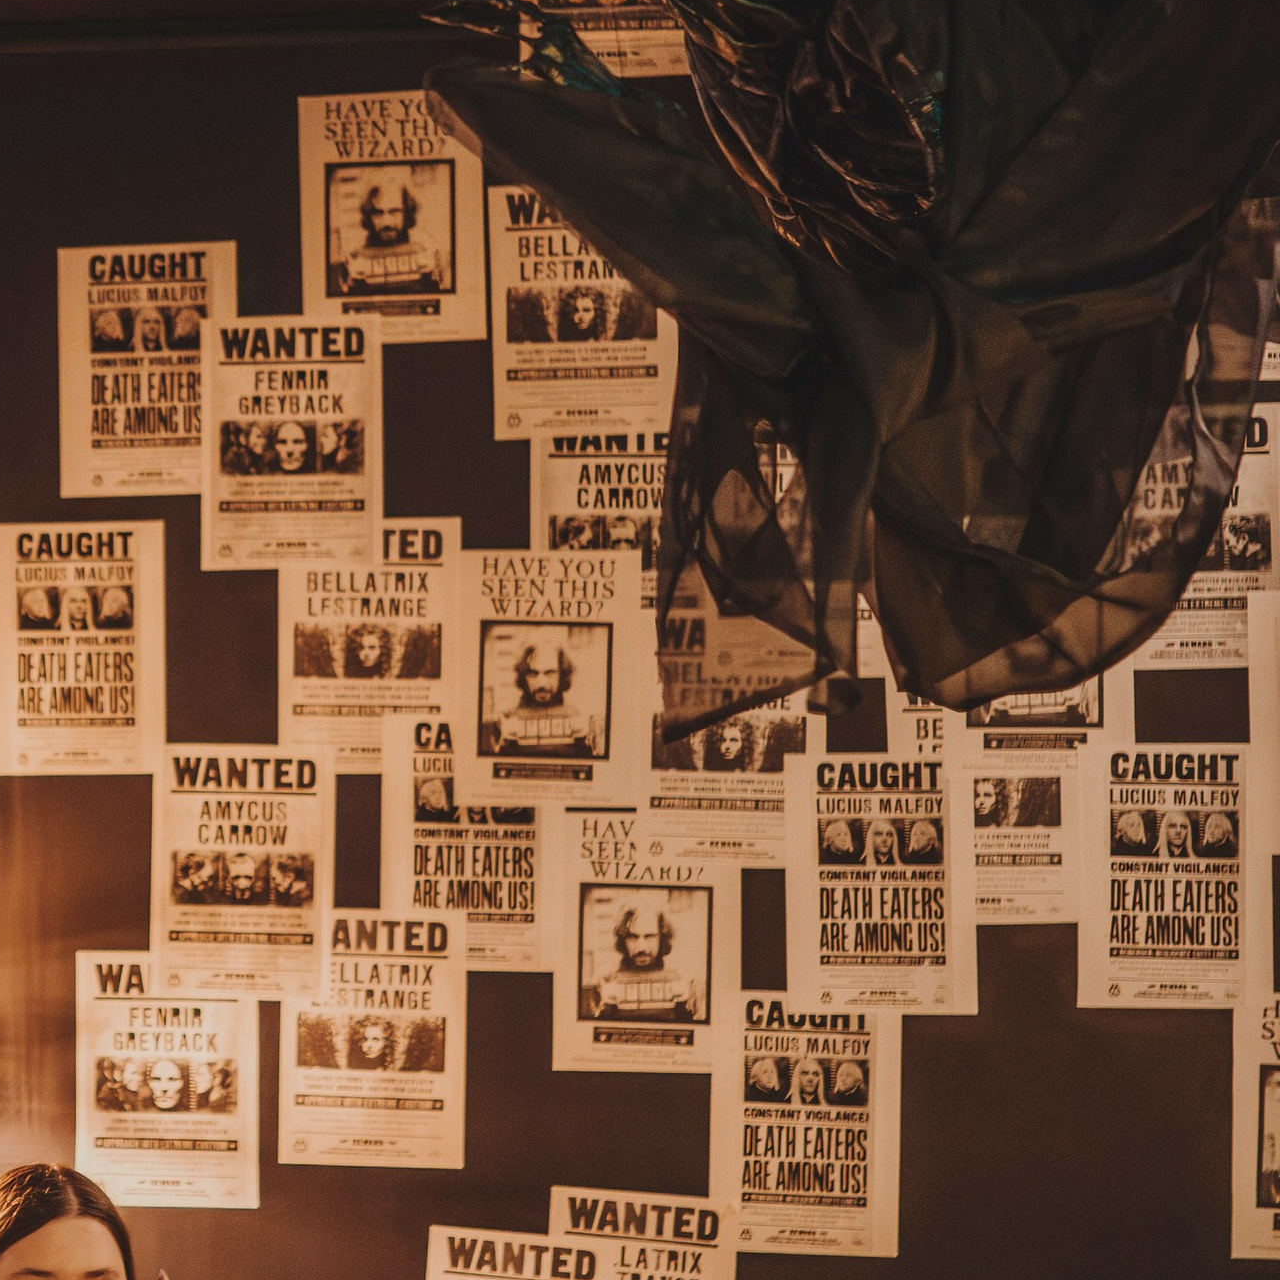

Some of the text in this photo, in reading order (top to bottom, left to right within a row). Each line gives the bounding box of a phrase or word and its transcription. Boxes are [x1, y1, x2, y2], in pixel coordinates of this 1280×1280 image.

[325, 100, 392, 120] HAVE
[324, 121, 387, 140] SEEN
[334, 138, 446, 158] WIZARD?
[518, 235, 590, 258] BELLA
[88, 251, 207, 281] CAUGHT
[520, 260, 614, 282] LESTRAN
[87, 285, 207, 305] LUCIUS MALFOY
[220, 327, 364, 359] WANTED
[91, 374, 141, 405] DEATH
[254, 370, 329, 391] FENRIR
[239, 393, 344, 416] GREYBACK
[91, 405, 201, 436] ARE AMONG US
[579, 463, 667, 485] AMYCUS
[17, 532, 133, 559] CAUGHT
[15, 566, 134, 583] LUCIUS MALFOY
[483, 557, 616, 577] HAVE YOU
[307, 571, 429, 593] BELLATRIX
[481, 577, 615, 599] SEEN THIS
[307, 596, 427, 618] LESTRANGE
[490, 598, 605, 618] WIZARD?
[17, 652, 135, 683] DEATH EATERS
[17, 685, 135, 715] ARE AMONG US!
[172, 757, 317, 790] WANTED
[817, 762, 942, 790] CAUGHT
[1110, 752, 1239, 781] CAUGHT
[816, 797, 943, 814] LUCIUS MALFOY
[1110, 789, 1240, 807] LUCIUS MALFOY
[200, 800, 287, 822] AMYCUS
[198, 824, 287, 846] CARROW
[582, 819, 635, 838] HAV
[413, 844, 534, 879] DEATH EATERS
[413, 879, 535, 910] ARE AMONG US!
[820, 887, 944, 920] DEATH EATERS
[1111, 879, 1238, 914] DEATH EATERS
[332, 920, 448, 952] ANTED
[820, 922, 946, 953] ARE AMONG US!
[1110, 914, 1240, 947] ARE AMONG US!
[130, 1007, 202, 1028] FENRIR
[113, 1031, 218, 1053] GREYBACK
[744, 1035, 871, 1056] LUCIUS MALFOY
[743, 1124, 867, 1161] DEATH EATERS
[742, 1160, 867, 1194] ARE AMONG US!
[568, 1197, 720, 1241] WANTED
[448, 1236, 596, 1280] WANTED
[620, 1245, 702, 1274] LATRIX
